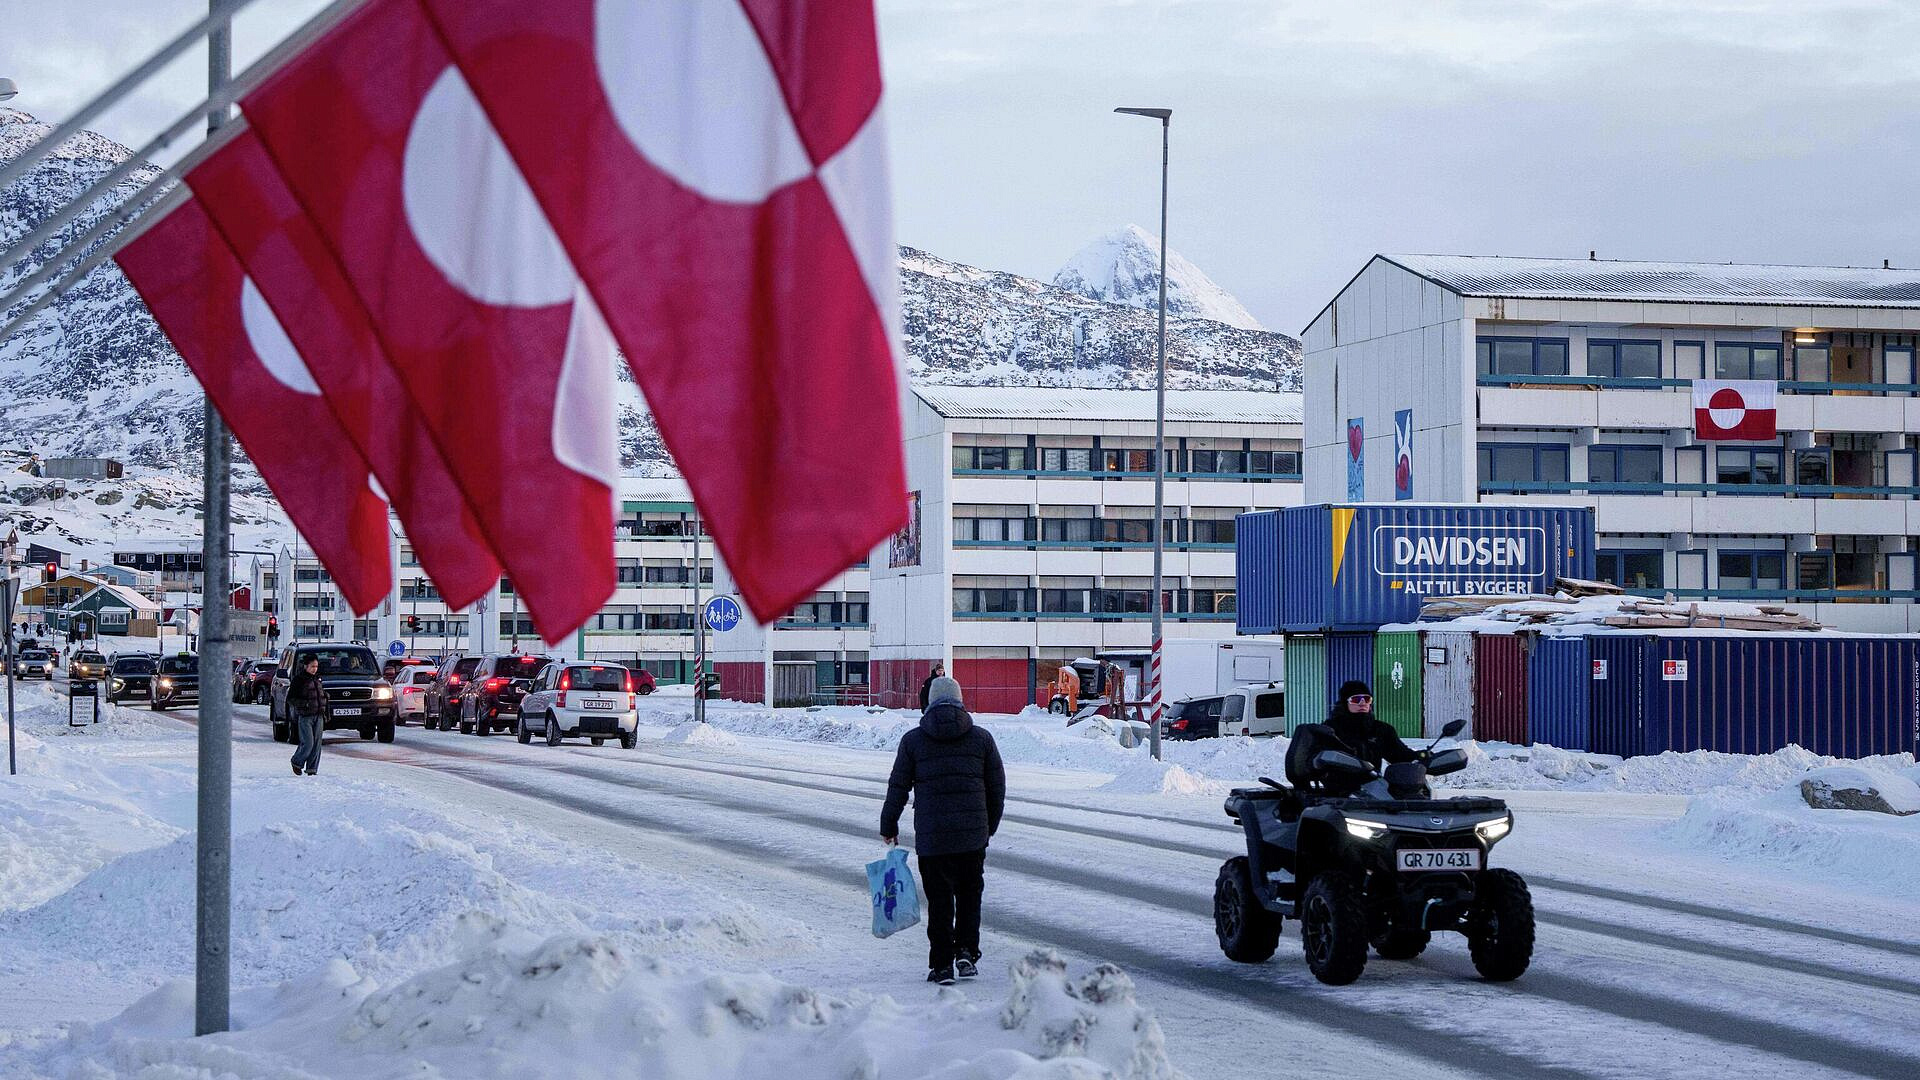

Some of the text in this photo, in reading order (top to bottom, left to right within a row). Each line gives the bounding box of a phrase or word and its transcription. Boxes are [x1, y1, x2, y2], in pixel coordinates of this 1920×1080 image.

[1394, 536, 1526, 566] DAVIDSEN
[1404, 581, 1532, 594] ALT TIL BYGGERI
[1404, 853, 1472, 867] GR 70 431
